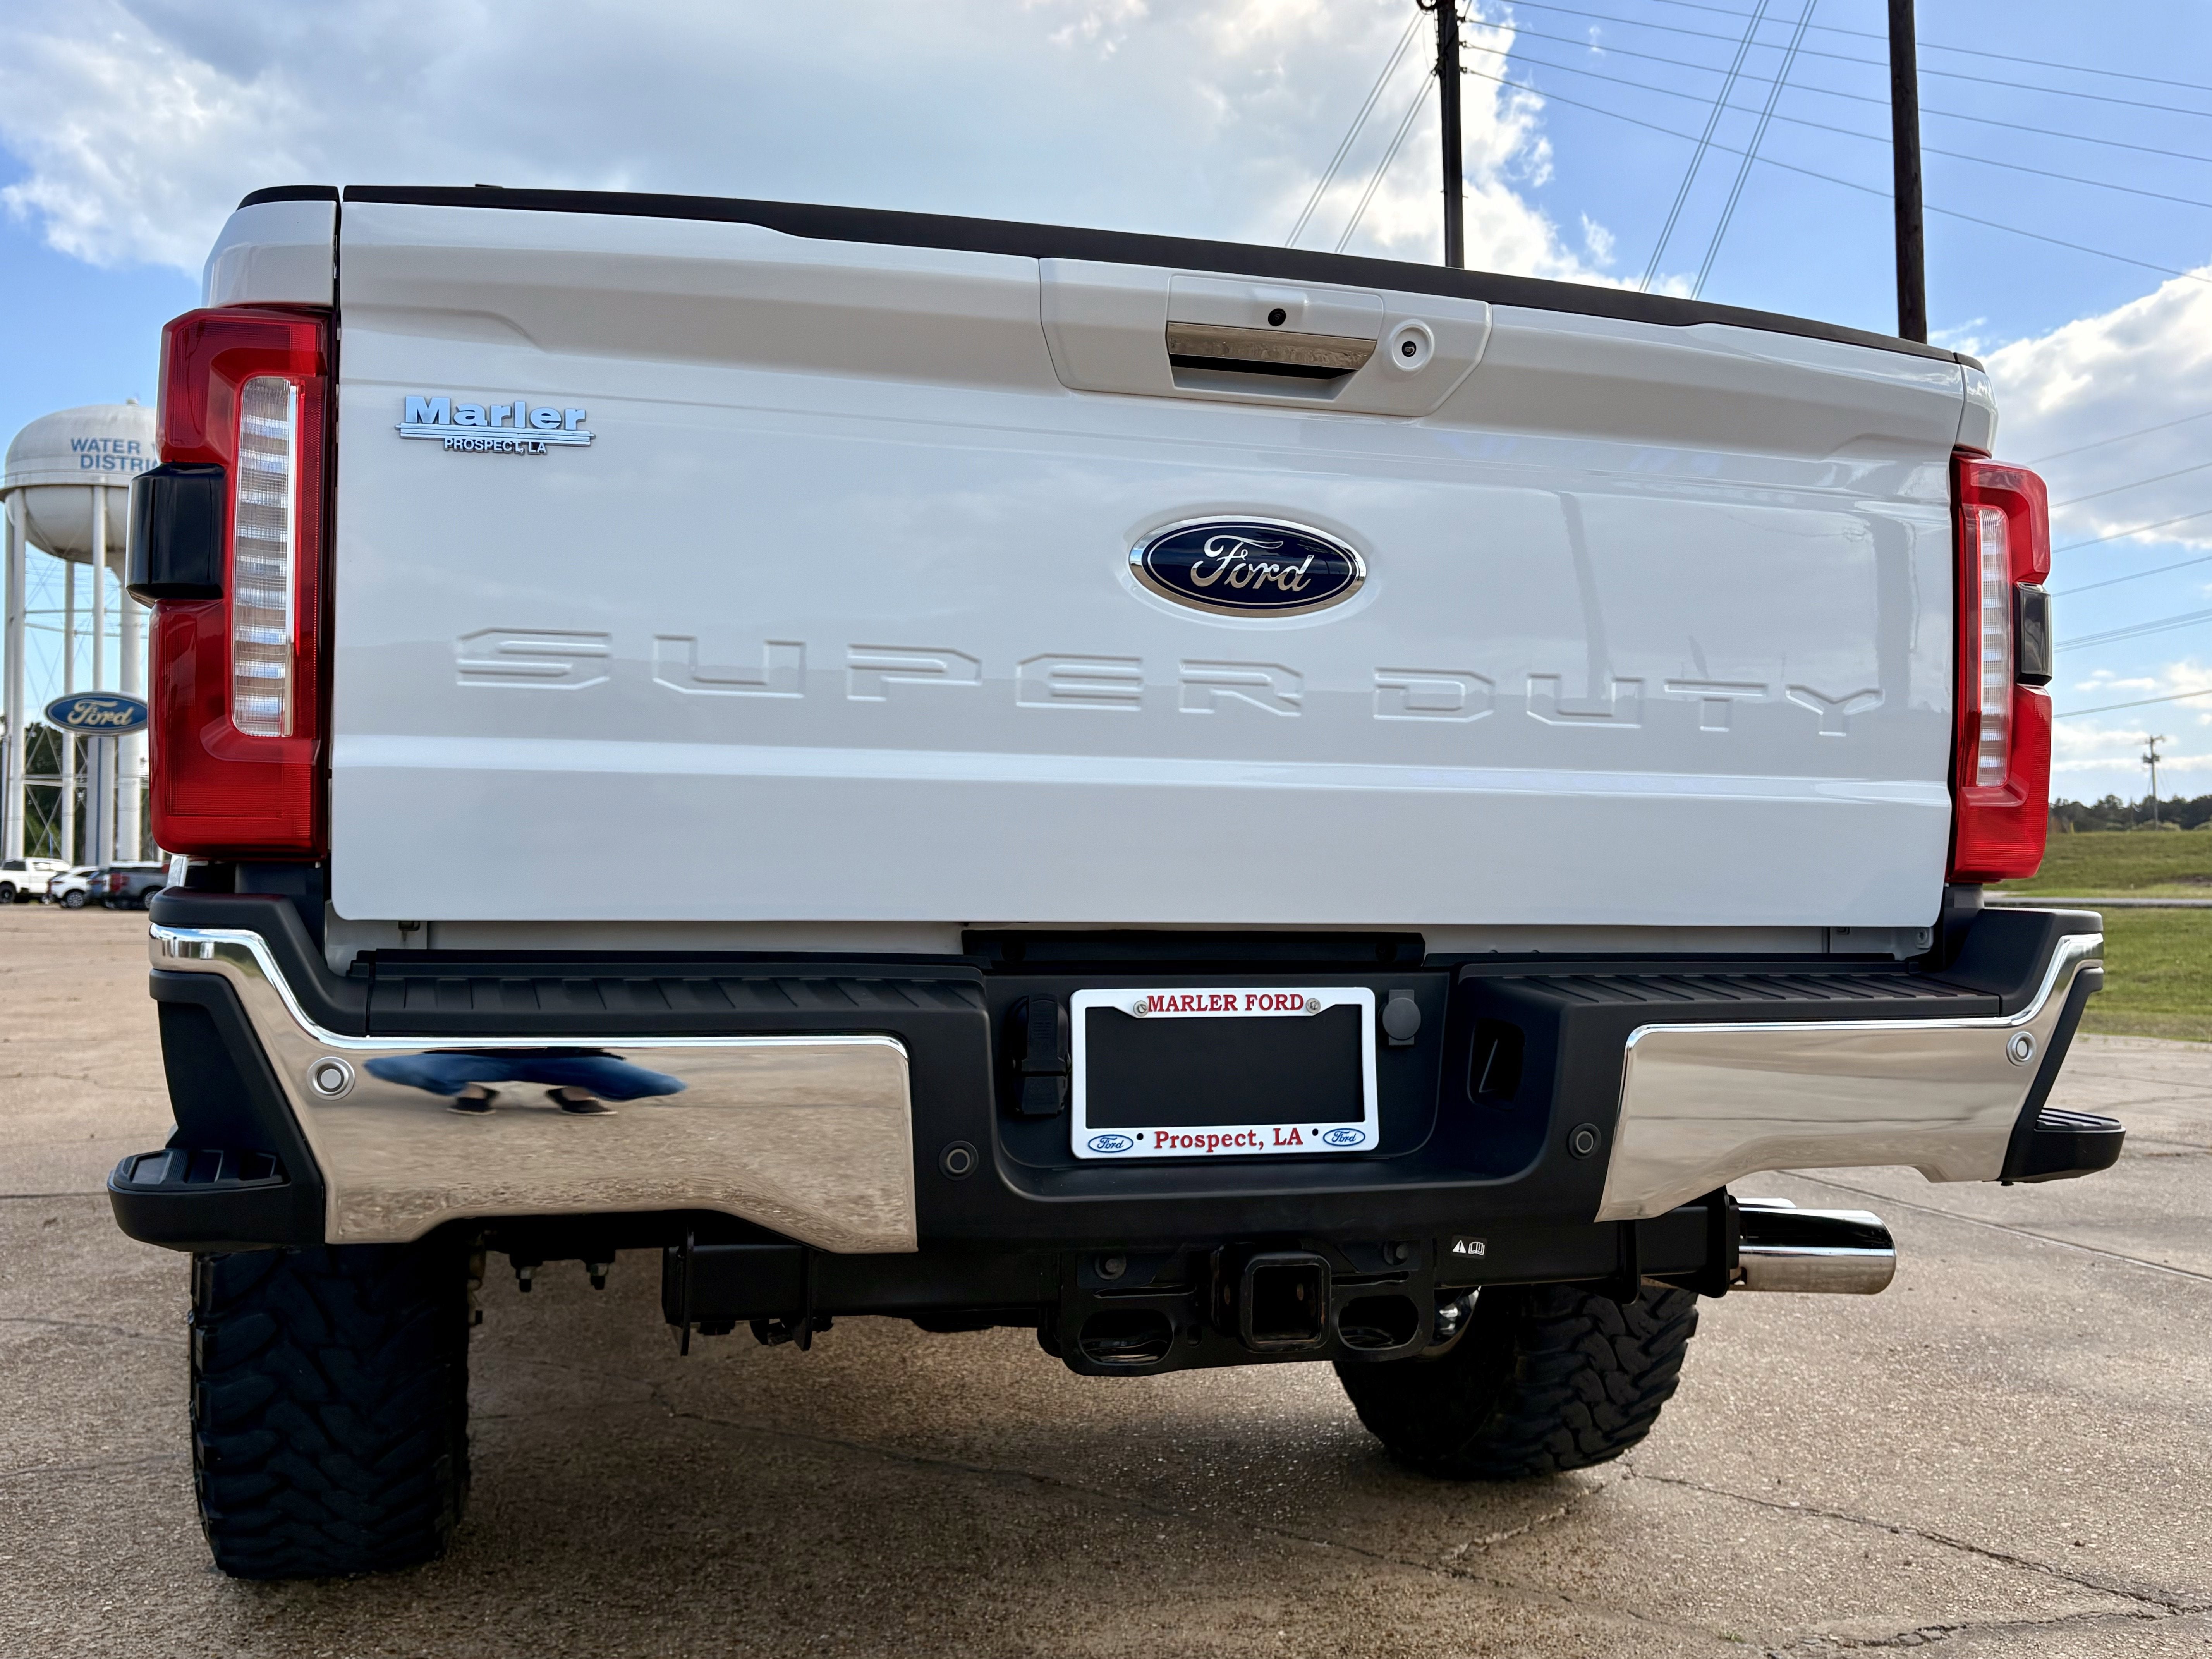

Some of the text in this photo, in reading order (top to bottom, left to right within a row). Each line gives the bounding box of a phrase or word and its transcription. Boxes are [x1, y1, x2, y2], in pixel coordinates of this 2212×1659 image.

[405, 395, 586, 430] Marler
[71, 437, 140, 454] WATER
[444, 438, 548, 455] PROSPECT, LA
[1190, 534, 1315, 592] Ford
[455, 627, 1886, 737] SUPER DUTY
[67, 699, 134, 725] Ford
[1147, 994, 1304, 1012] MARLER FORD
[1097, 1137, 1125, 1149] Ford
[1154, 1127, 1304, 1153] Prospect, LA
[1331, 1131, 1357, 1143] Ford
